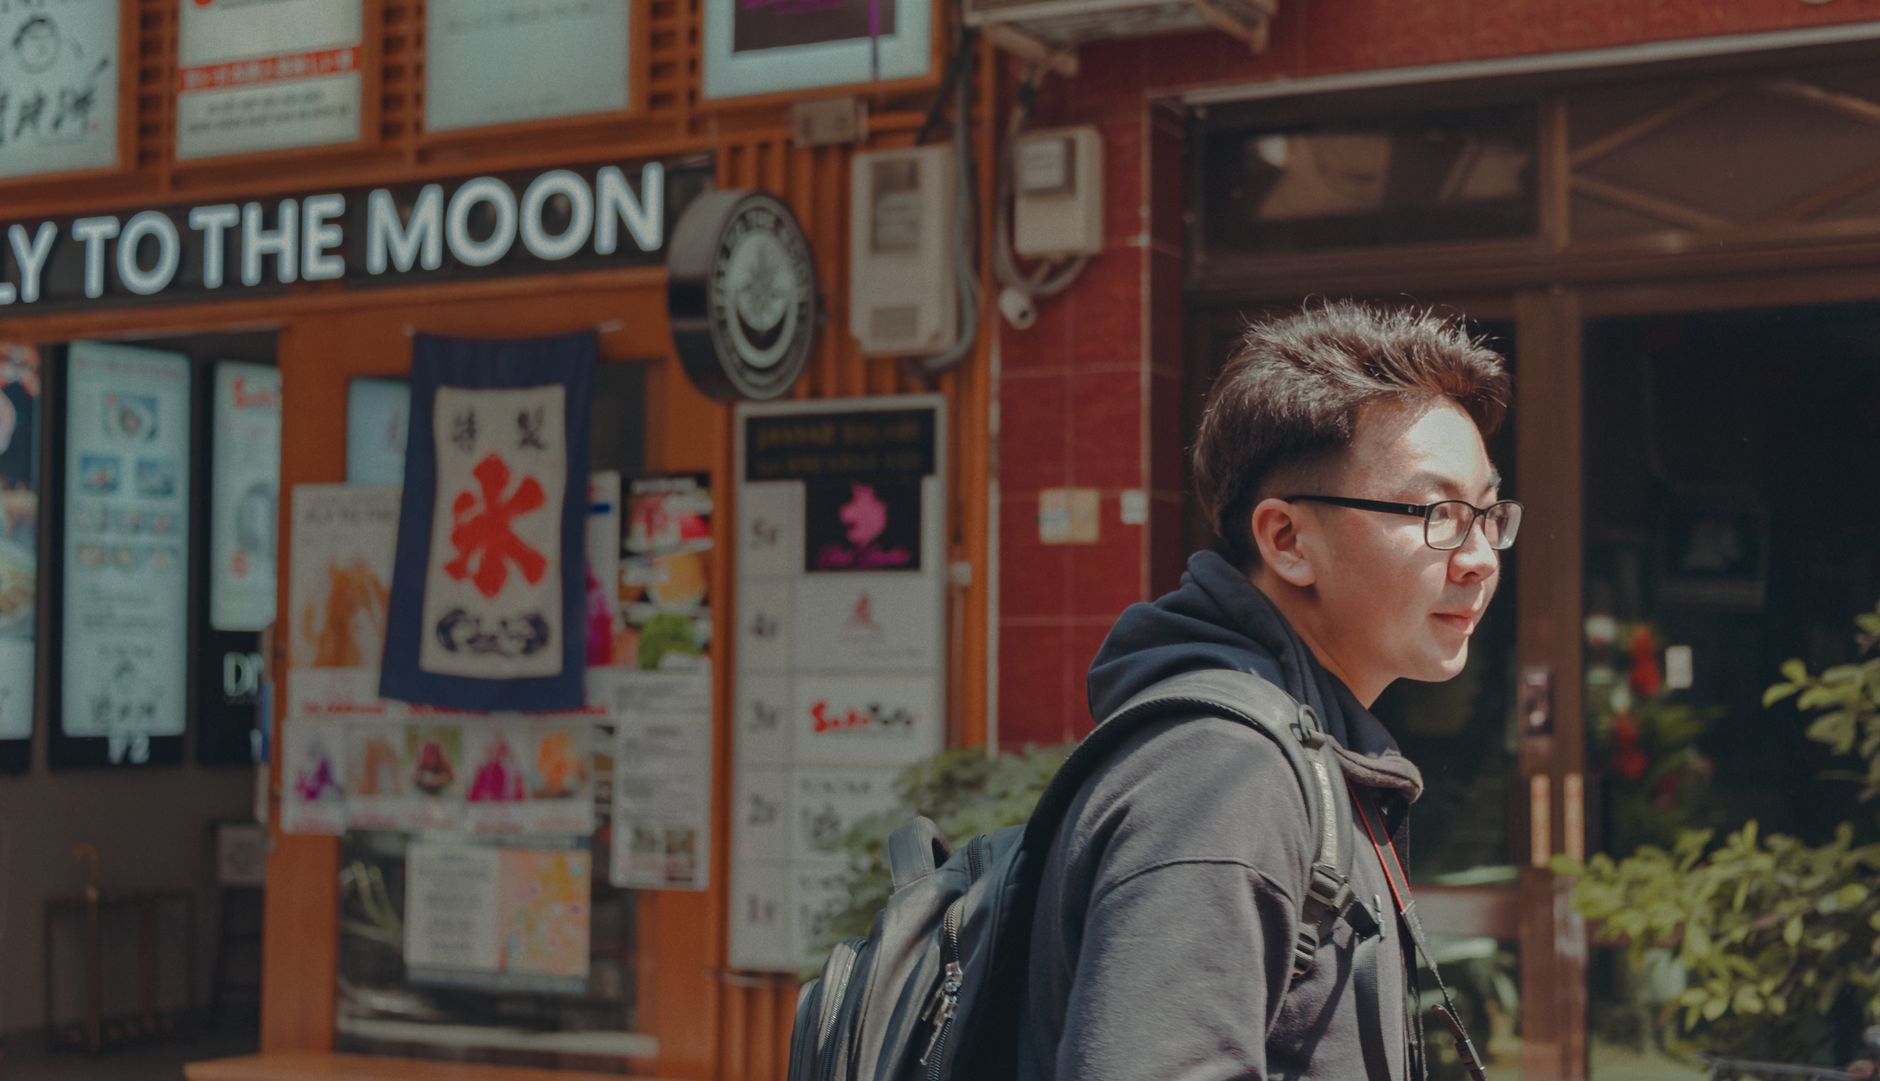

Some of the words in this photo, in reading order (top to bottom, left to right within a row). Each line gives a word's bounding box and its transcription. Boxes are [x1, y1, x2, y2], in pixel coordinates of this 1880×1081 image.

[71, 209, 181, 299] TO
[188, 194, 346, 289] THE
[366, 161, 664, 275] MOON
